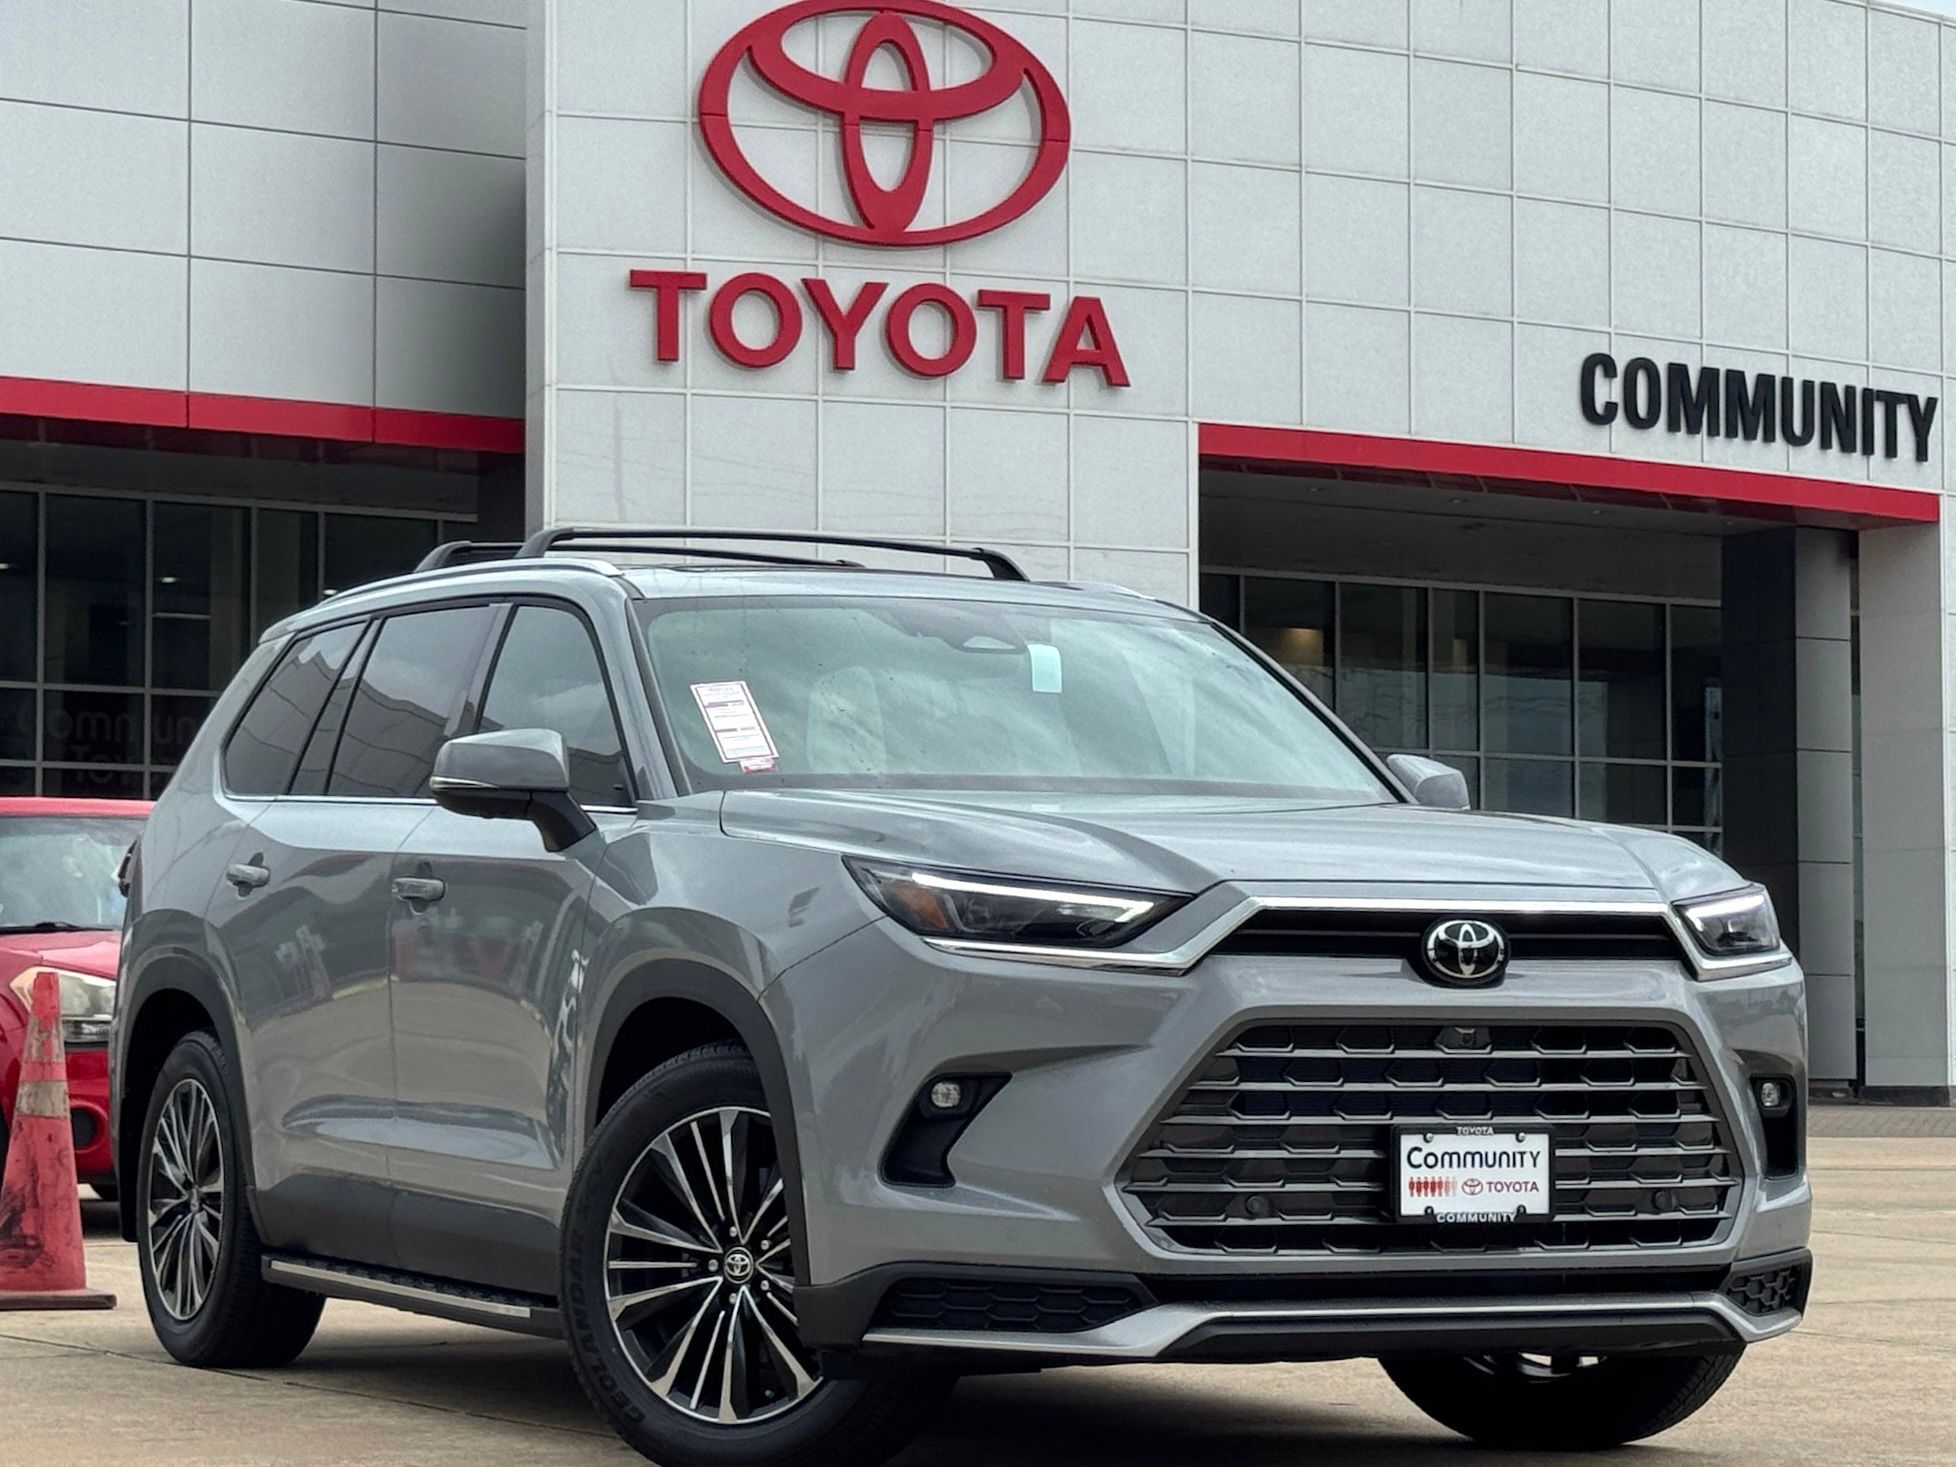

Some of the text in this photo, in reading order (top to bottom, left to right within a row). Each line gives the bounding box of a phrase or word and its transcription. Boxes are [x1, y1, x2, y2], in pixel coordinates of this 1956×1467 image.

[629, 268, 1131, 387] TOYOTA
[1580, 352, 1939, 463] COMMUNITY
[1456, 1126, 1495, 1136] TOYOTA
[1486, 1181, 1540, 1193] TOYOTA
[1436, 1212, 1517, 1223] COMMUNITY
